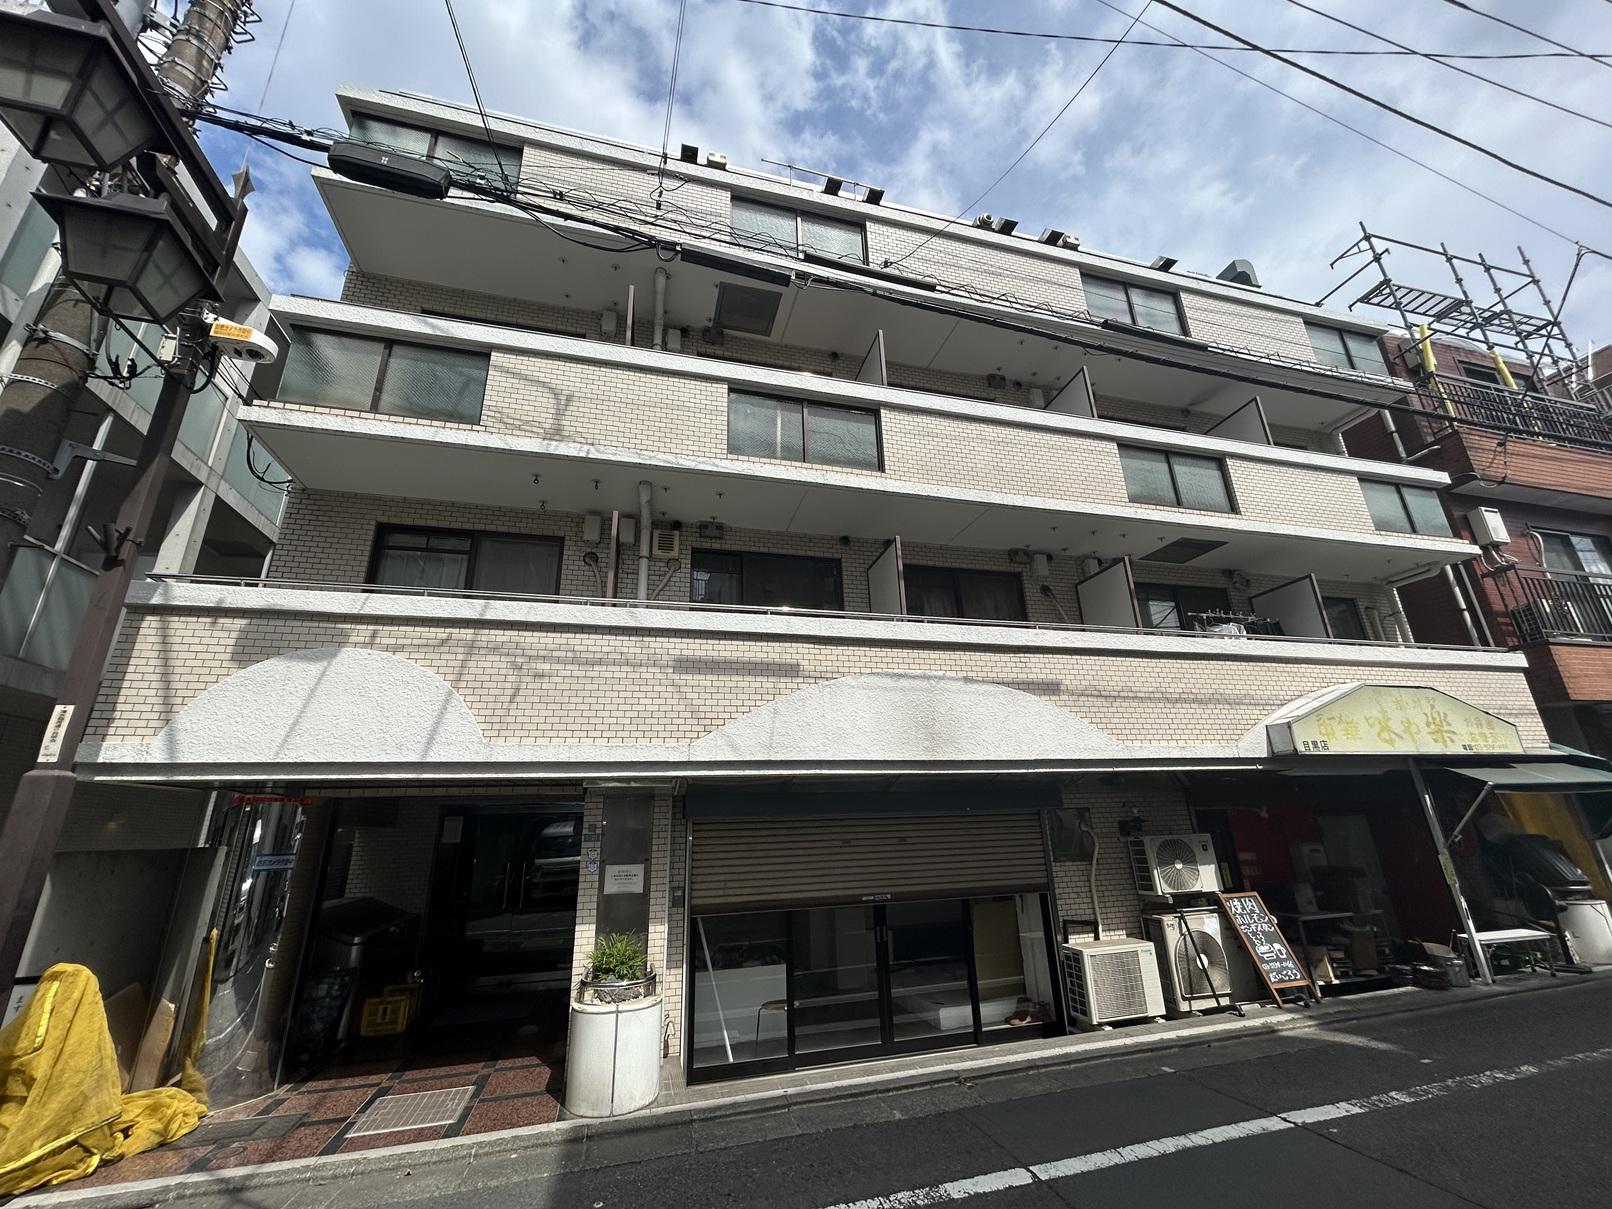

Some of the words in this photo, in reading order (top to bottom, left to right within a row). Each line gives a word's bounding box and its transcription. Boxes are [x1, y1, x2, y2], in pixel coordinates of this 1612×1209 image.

[1302, 739, 1330, 752] 目黒店
[1227, 897, 1260, 915] 焼肉
[1235, 913, 1269, 925] ホルモン
